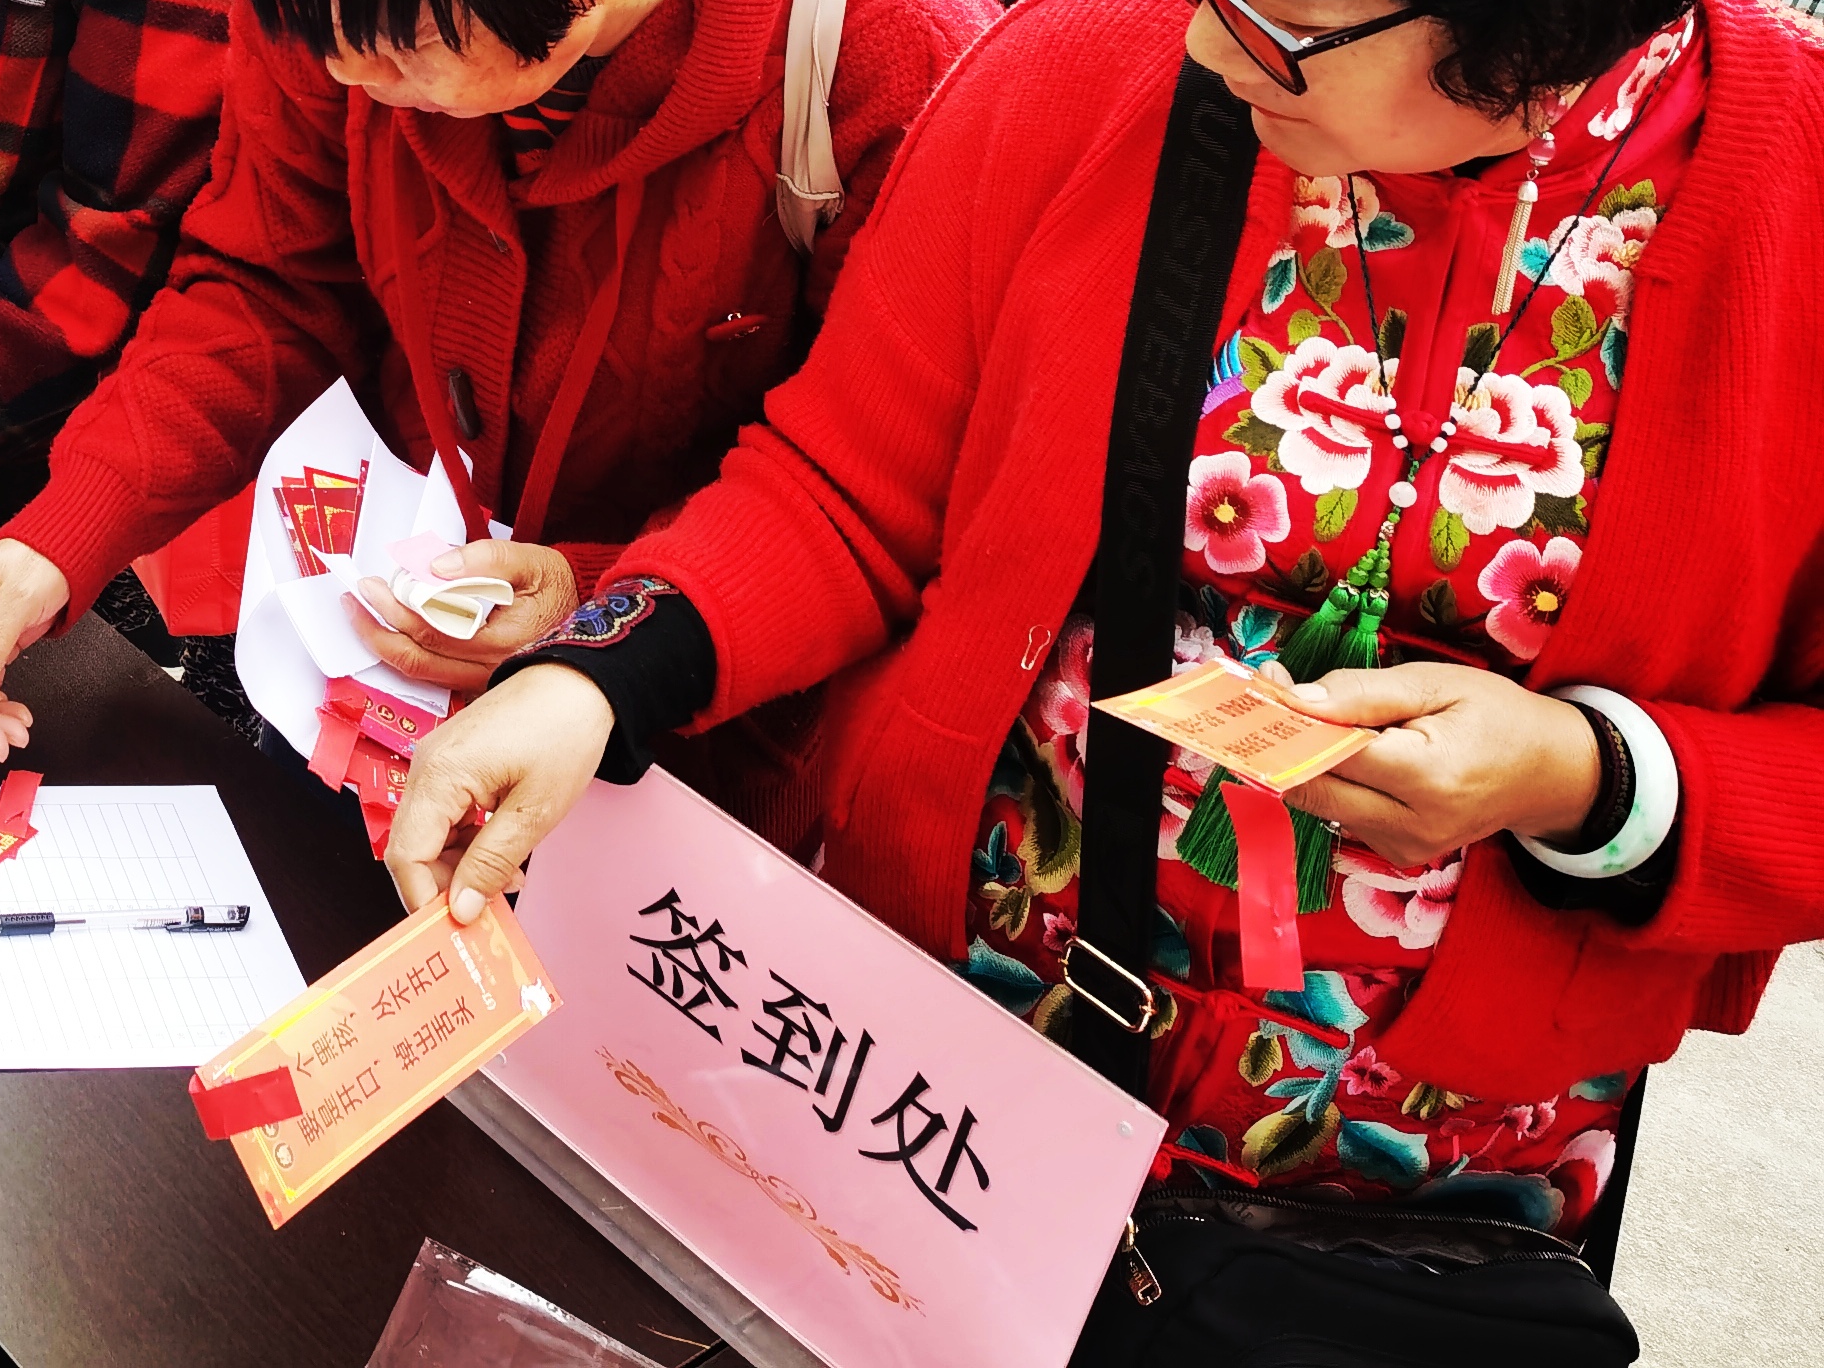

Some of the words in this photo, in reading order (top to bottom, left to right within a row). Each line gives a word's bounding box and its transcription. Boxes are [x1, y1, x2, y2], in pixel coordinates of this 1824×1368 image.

[295, 951, 451, 1078] 个黑孩，从不开口
[625, 887, 991, 1233] 签到处
